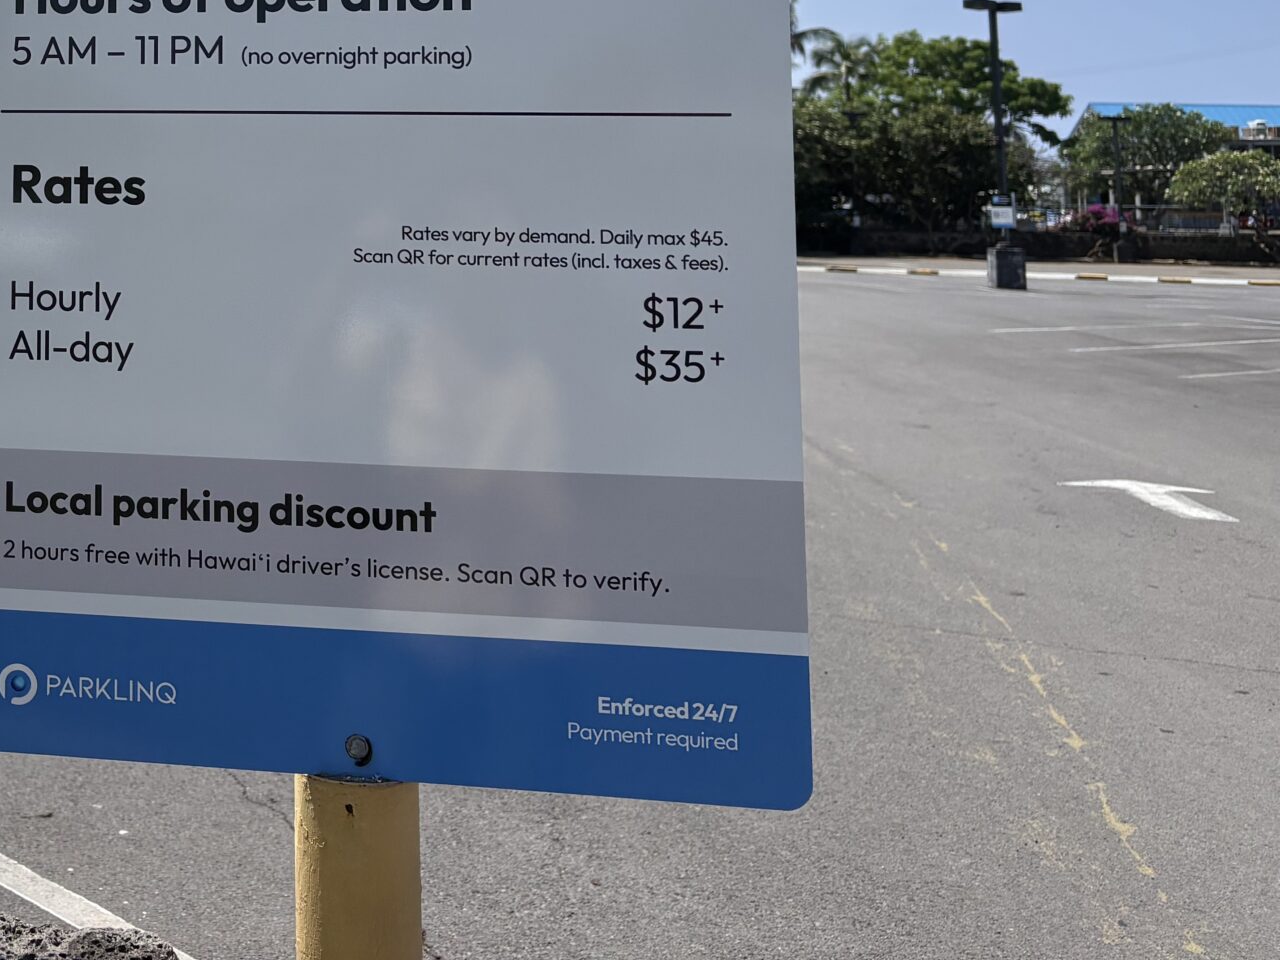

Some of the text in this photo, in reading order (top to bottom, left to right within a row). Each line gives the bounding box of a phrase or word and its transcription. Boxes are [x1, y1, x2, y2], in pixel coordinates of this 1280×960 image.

[13, 36, 31, 65] 5
[40, 36, 96, 65] AM
[135, 36, 158, 65] 11
[171, 35, 224, 65] PM
[241, 46, 273, 67] (no
[278, 45, 380, 70] overnight
[384, 45, 472, 70] parking)
[12, 164, 145, 206] Rates
[402, 225, 728, 250] Rates vary by demand. Daily max $45.
[353, 248, 728, 272] Scan QR for current rates (incl. taxes & fees).
[11, 280, 121, 320] Hourly
[9, 329, 134, 372] All-day
[5, 480, 437, 534] Local parking discount
[3, 540, 16, 559] 2
[22, 540, 79, 562] hours
[85, 542, 130, 565] free
[136, 547, 181, 568] with
[277, 554, 361, 578] driver’s
[367, 558, 449, 582] license.
[457, 563, 513, 585] Scan
[520, 566, 556, 588] QR
[562, 568, 588, 589] to
[593, 570, 669, 598] verify.
[47, 674, 177, 705] PARKLINQ
[597, 695, 738, 724] Enforced 24/7
[567, 722, 738, 752] Payment required
